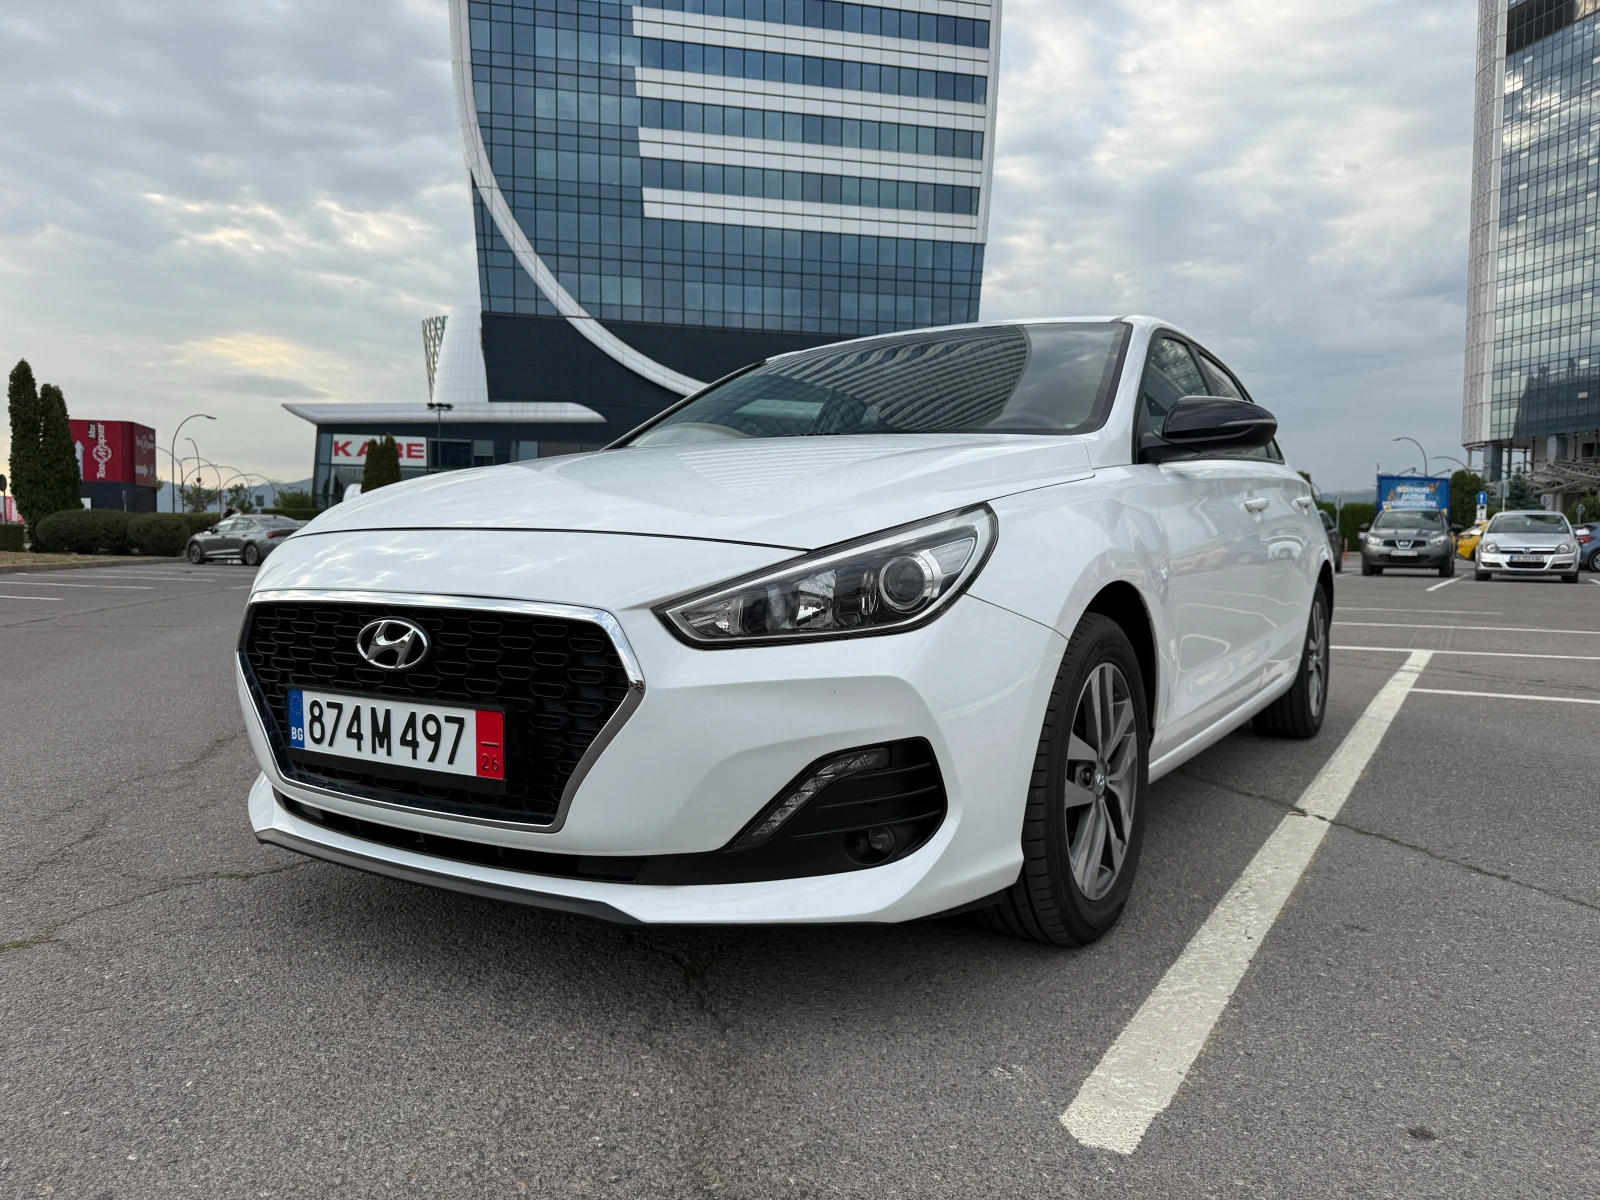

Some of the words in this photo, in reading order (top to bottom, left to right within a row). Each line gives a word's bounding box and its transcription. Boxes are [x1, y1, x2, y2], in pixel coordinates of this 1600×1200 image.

[291, 726, 304, 741] BG
[308, 699, 465, 765] 874M497
[481, 753, 499, 771] 26
